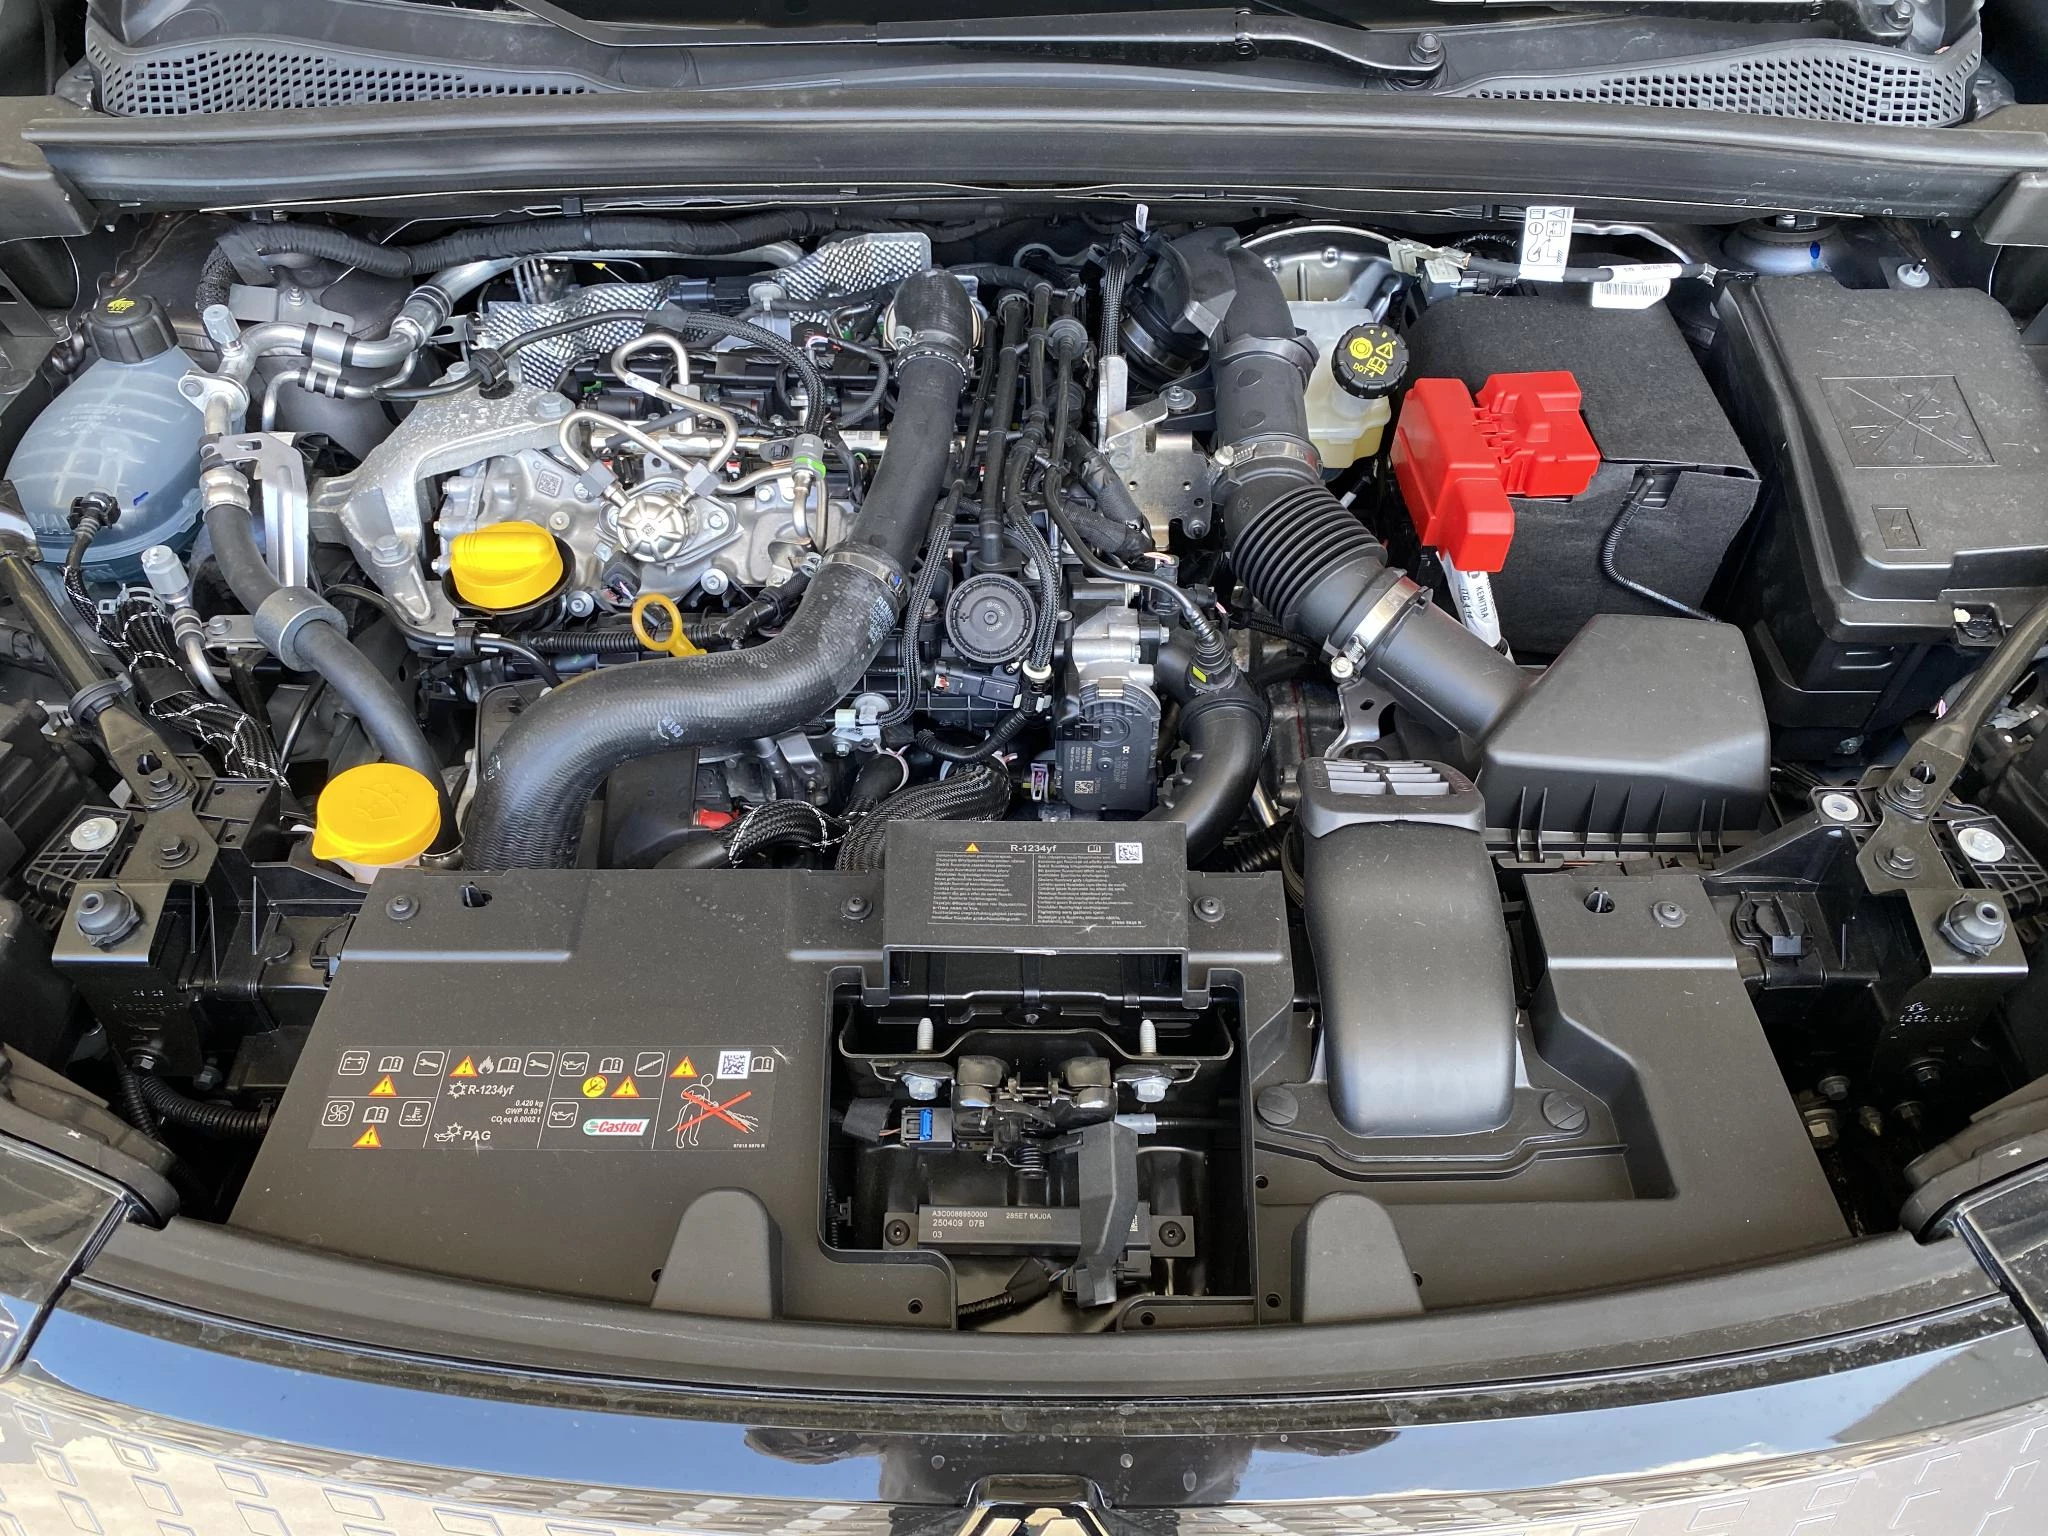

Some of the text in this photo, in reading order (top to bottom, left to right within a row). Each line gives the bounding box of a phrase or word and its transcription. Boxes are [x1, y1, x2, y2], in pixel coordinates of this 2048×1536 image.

[1353, 362, 1369, 374] DOT
[1476, 586, 1489, 619] KENITRA
[1010, 844, 1057, 854] R-1234yf
[468, 1085, 515, 1097] R-1234yf
[515, 1099, 544, 1108] 0.420 kg
[505, 1107, 523, 1115] GWP
[598, 1121, 643, 1133] Castrol
[462, 1130, 492, 1141] PAG
[932, 1219, 985, 1228] 250409 07B
[932, 1230, 943, 1239] 03
